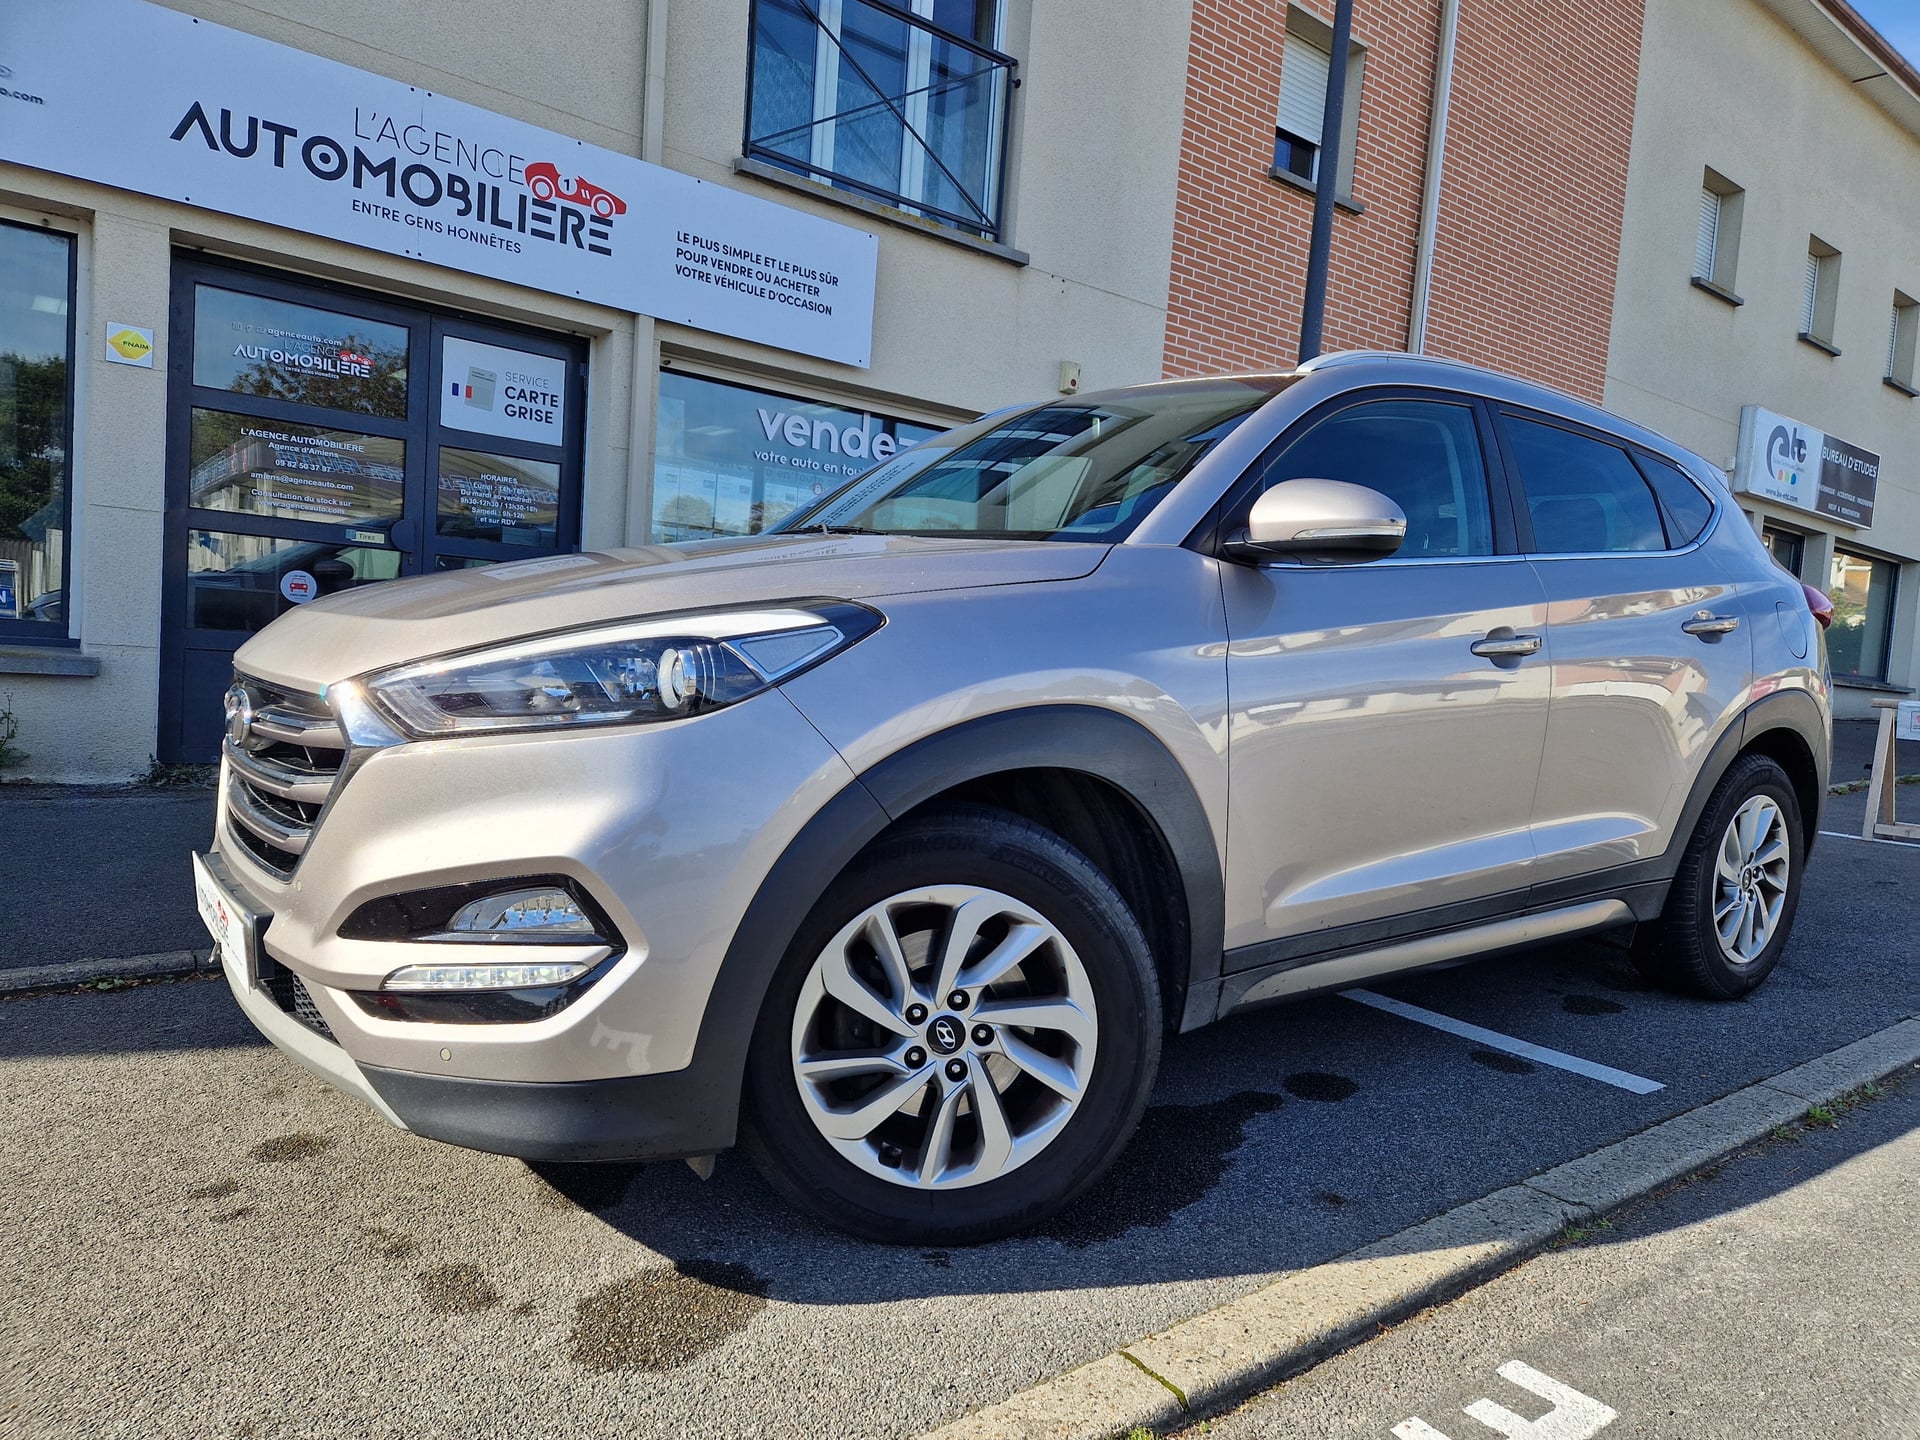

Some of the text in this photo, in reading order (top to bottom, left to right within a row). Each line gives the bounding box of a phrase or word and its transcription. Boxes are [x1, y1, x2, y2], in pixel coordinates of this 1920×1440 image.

[354, 107, 525, 185] L'AGENCE
[169, 100, 613, 257] AUTOMOBILIERE
[352, 199, 522, 253] ENTRE GENS HONNÊTES
[677, 230, 839, 287] LE PLUS SIMPLE ET LE PLUS SÛR
[676, 247, 820, 297] POUR VENDRE OU ACHETER
[675, 263, 833, 316] VOTRE VÉHICULE D'OCCASION
[122, 340, 149, 350] FNAIM
[267, 326, 342, 347] agenceauto.com
[284, 339, 341, 358] L'AGENCE
[505, 371, 549, 389] SERVICE
[504, 386, 559, 408] CARTE
[504, 404, 553, 424] GRISE
[240, 427, 365, 453] L'AGENCE AUTOMOBILIERE
[756, 408, 919, 462] vende
[268, 441, 339, 458] Agence d'Amiens
[1822, 446, 1848, 467] BUREAU
[754, 450, 787, 465] votre
[791, 456, 819, 470] auto
[824, 463, 838, 474] en
[250, 471, 354, 491] amiens@agenceauto.com
[473, 482, 493, 490] Lundi
[480, 473, 518, 484] HORAIRES
[251, 488, 302, 501] Consultation
[304, 495, 314, 503] du
[316, 497, 337, 505] stock
[472, 490, 491, 498] mardi
[259, 500, 345, 515] www.agenceauto.com
[471, 507, 497, 516] Samedi
